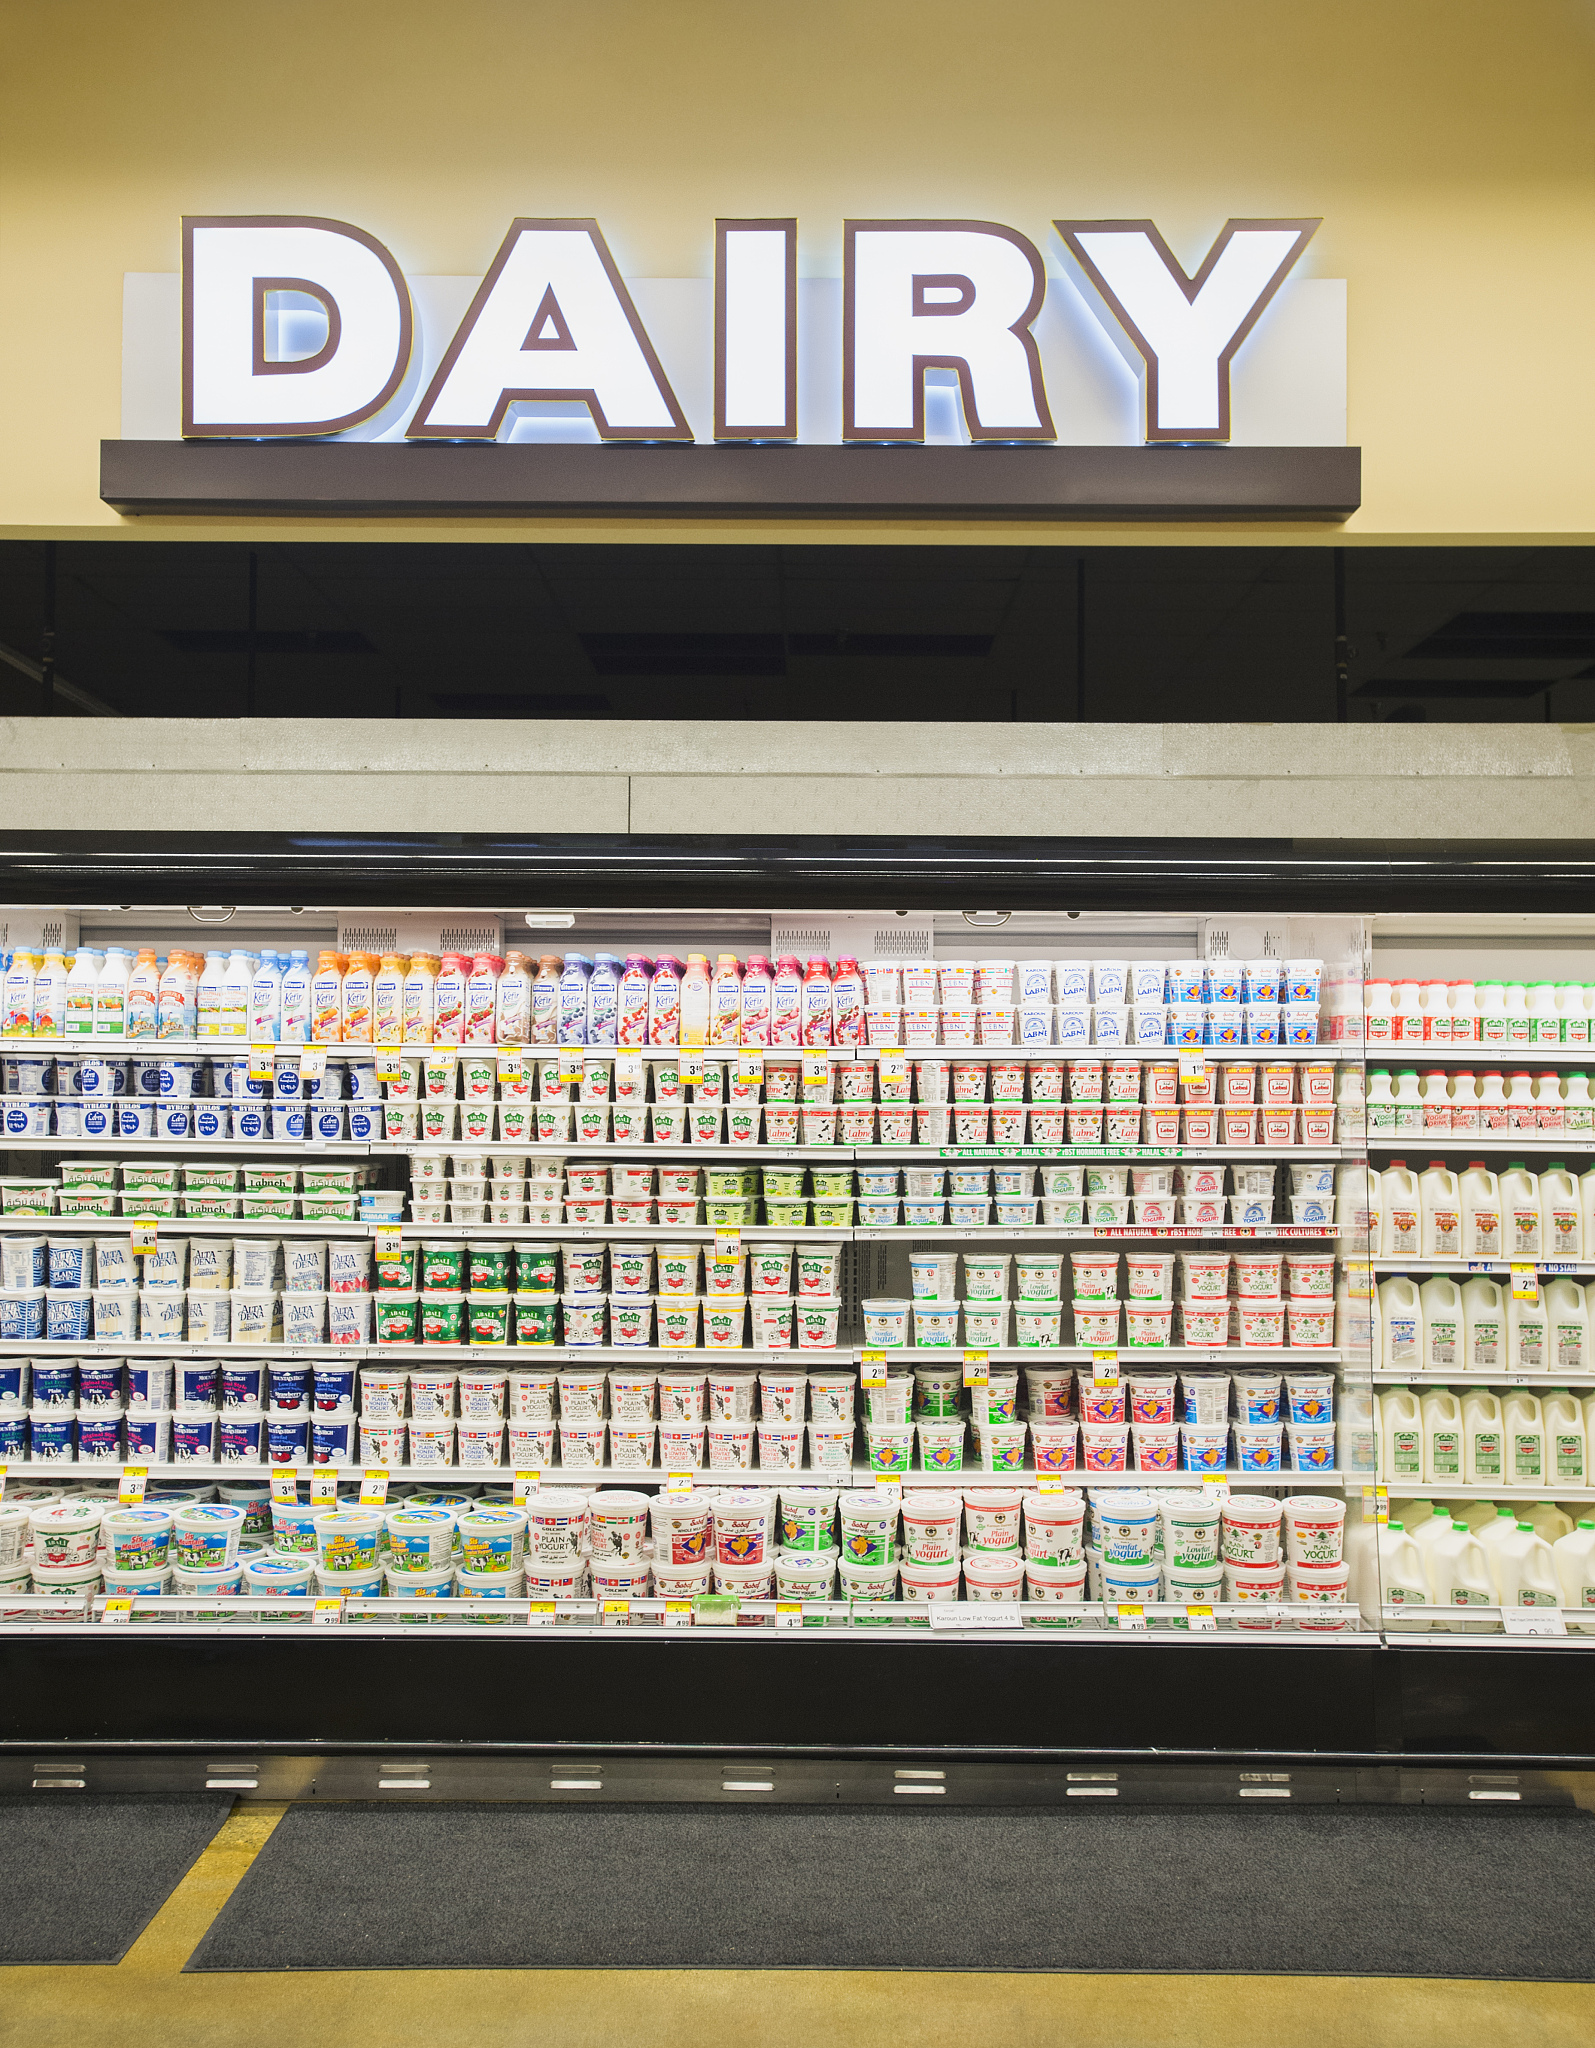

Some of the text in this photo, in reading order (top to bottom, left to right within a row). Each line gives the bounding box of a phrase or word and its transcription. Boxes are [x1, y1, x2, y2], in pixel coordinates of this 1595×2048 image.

[181, 215, 1323, 446] DAIRY
[53, 1251, 75, 1260] ALTA
[99, 1250, 121, 1259] ALTA
[154, 1251, 176, 1259] ALTA
[196, 1250, 215, 1259] ALTA
[297, 1253, 317, 1261] ALTA
[335, 1254, 354, 1262] ALTA
[970, 1288, 994, 1296] yogurt
[1027, 1288, 1052, 1296] yogurt
[1077, 1287, 1101, 1295] yogurt
[51, 1303, 73, 1312] ALTA
[97, 1304, 119, 1312] ALTA
[1090, 1335, 1114, 1343] yogurt
[46, 1539, 67, 1547] ABALI
[131, 1535, 143, 1543] Sis
[334, 1535, 345, 1543] Sis
[982, 1535, 1014, 1545] yogurt
[915, 1549, 948, 1560] yogurt
[1109, 1549, 1143, 1558] yogurt
[1181, 1552, 1214, 1562] yogurt
[1303, 1550, 1338, 1558] YOGURT
